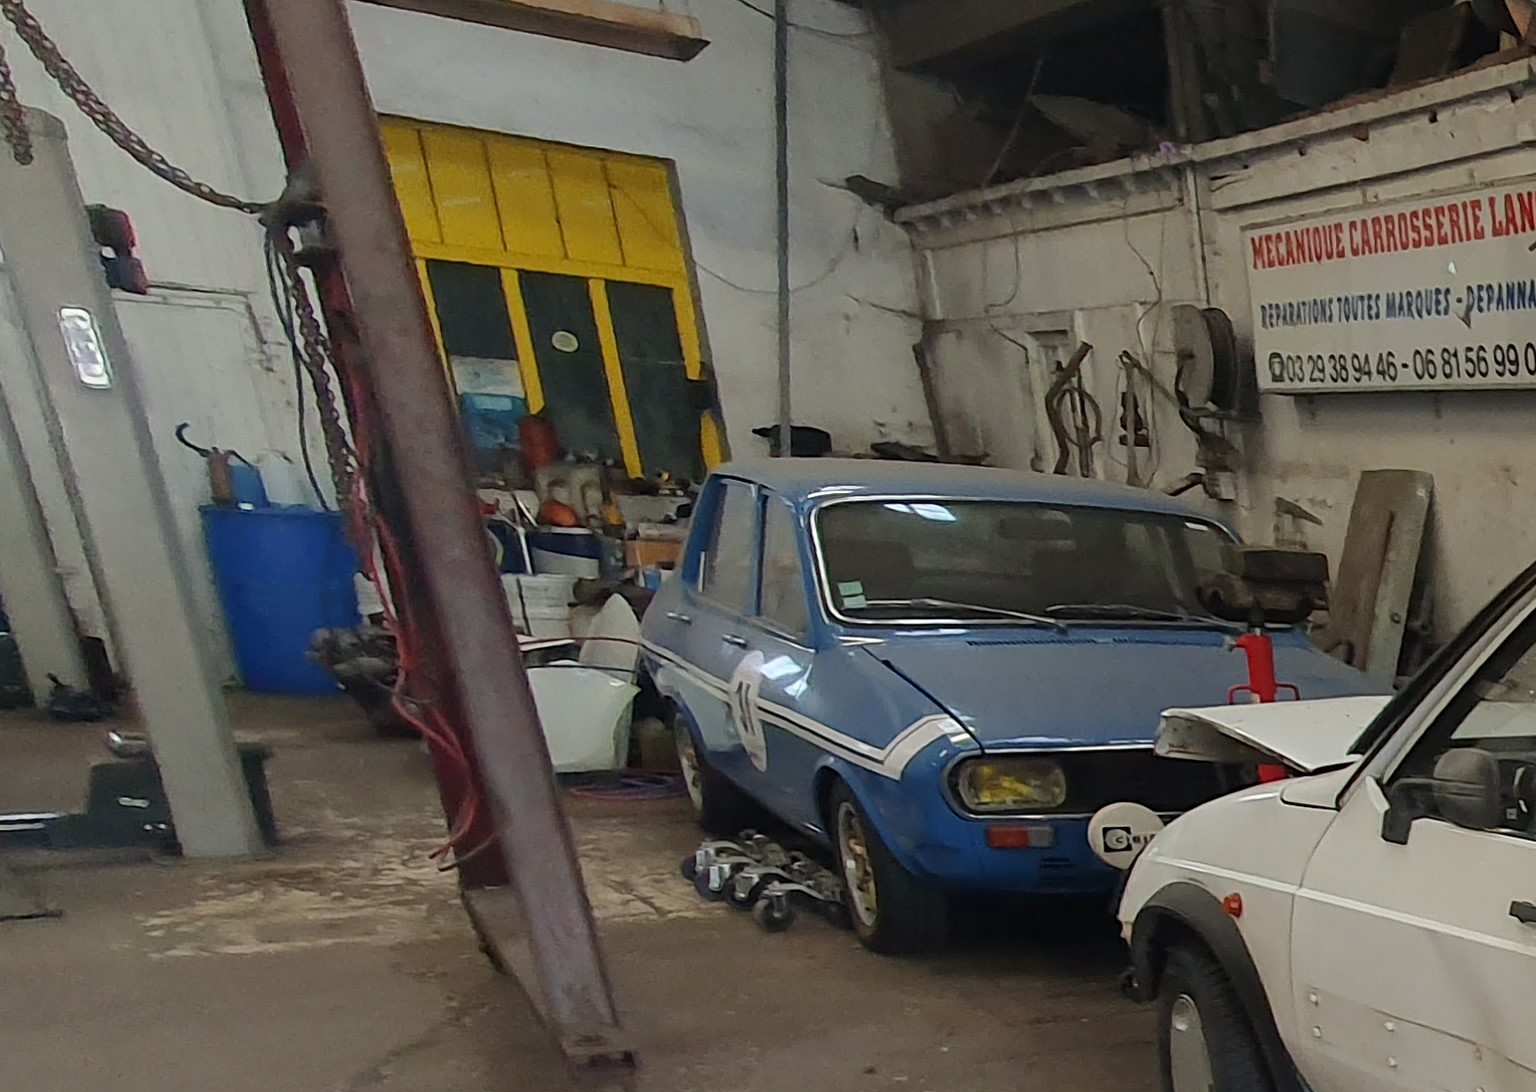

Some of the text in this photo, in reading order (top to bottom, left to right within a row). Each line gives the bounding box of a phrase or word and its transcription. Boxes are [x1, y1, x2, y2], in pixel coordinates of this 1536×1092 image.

[1250, 222, 1346, 270] MECANIQUE
[1349, 199, 1485, 257] CARROSSERIE
[1337, 293, 1381, 323] TOUTES
[1386, 288, 1452, 319] MARQUES
[1286, 354, 1305, 383] 03
[1307, 354, 1326, 383] 29
[1328, 354, 1349, 383] 38
[1351, 353, 1372, 382] 94
[1376, 351, 1398, 382] 46
[1413, 349, 1437, 380] 06
[1494, 344, 1519, 377] 99
